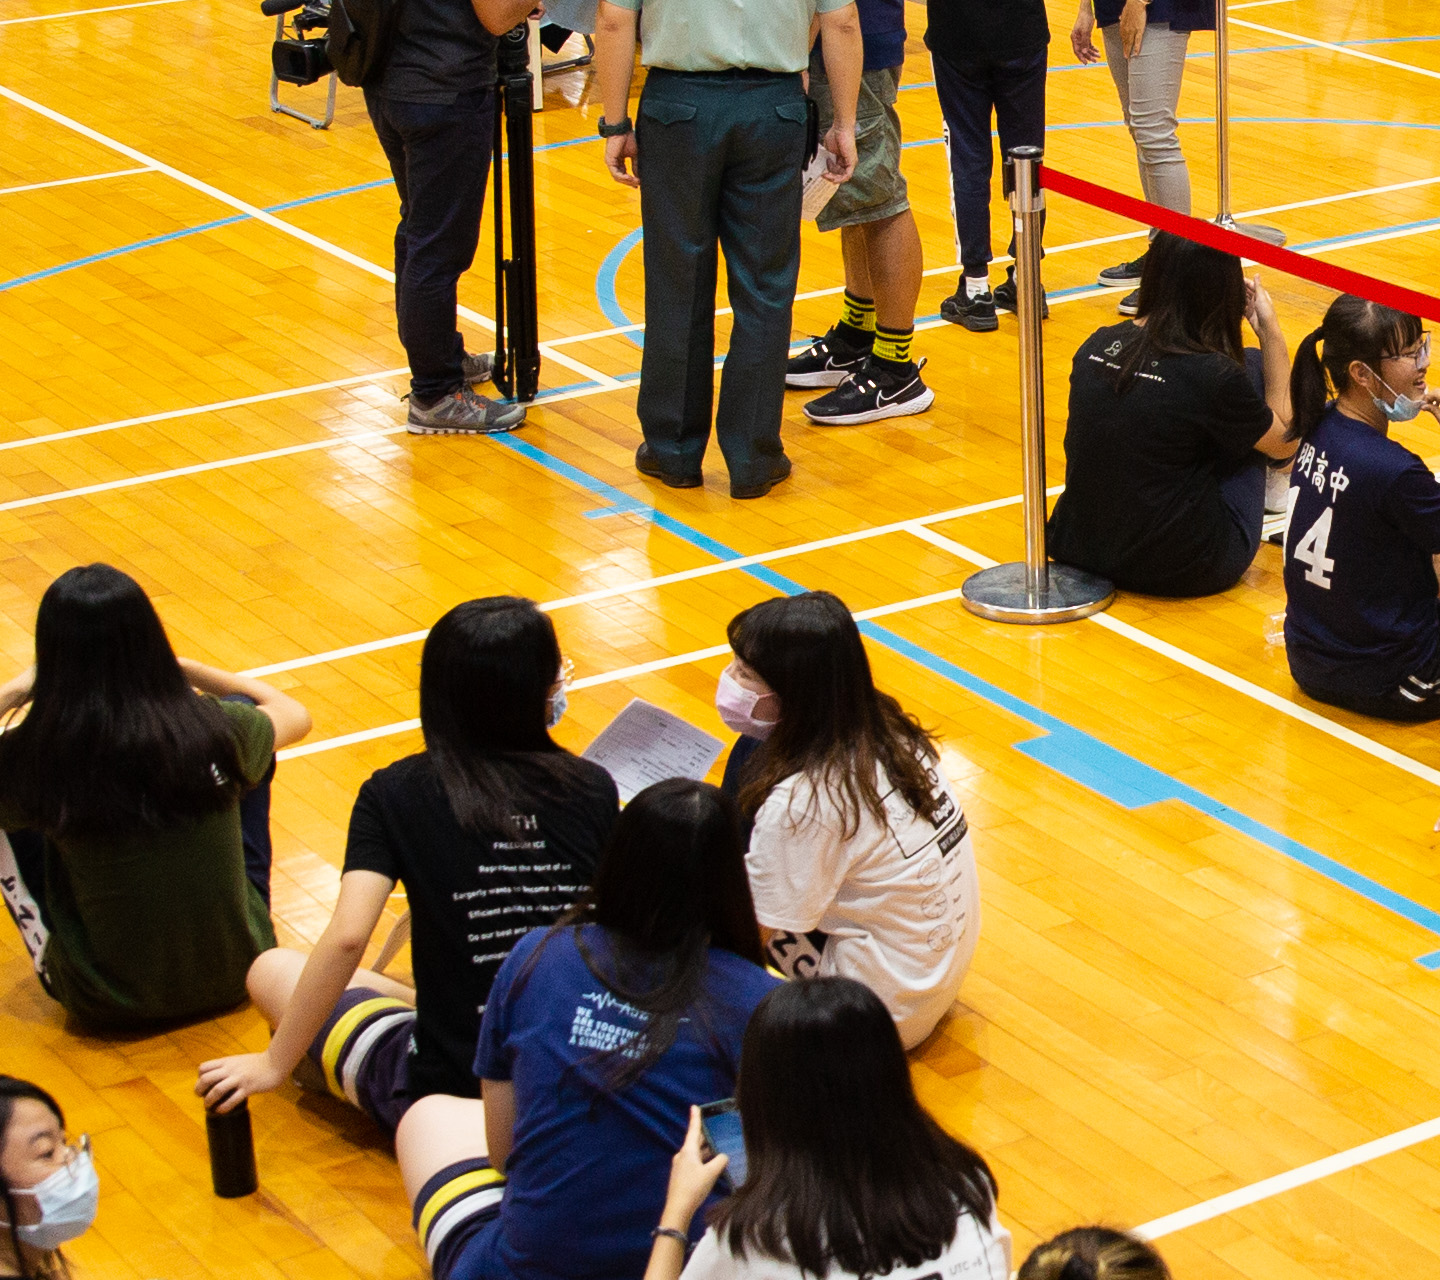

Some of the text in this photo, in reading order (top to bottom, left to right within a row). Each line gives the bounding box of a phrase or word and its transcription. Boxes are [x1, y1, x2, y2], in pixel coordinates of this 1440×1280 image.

[576, 1006, 592, 1018] WE
[573, 1016, 594, 1027] ARE
[571, 1024, 617, 1043] BECAUSE
